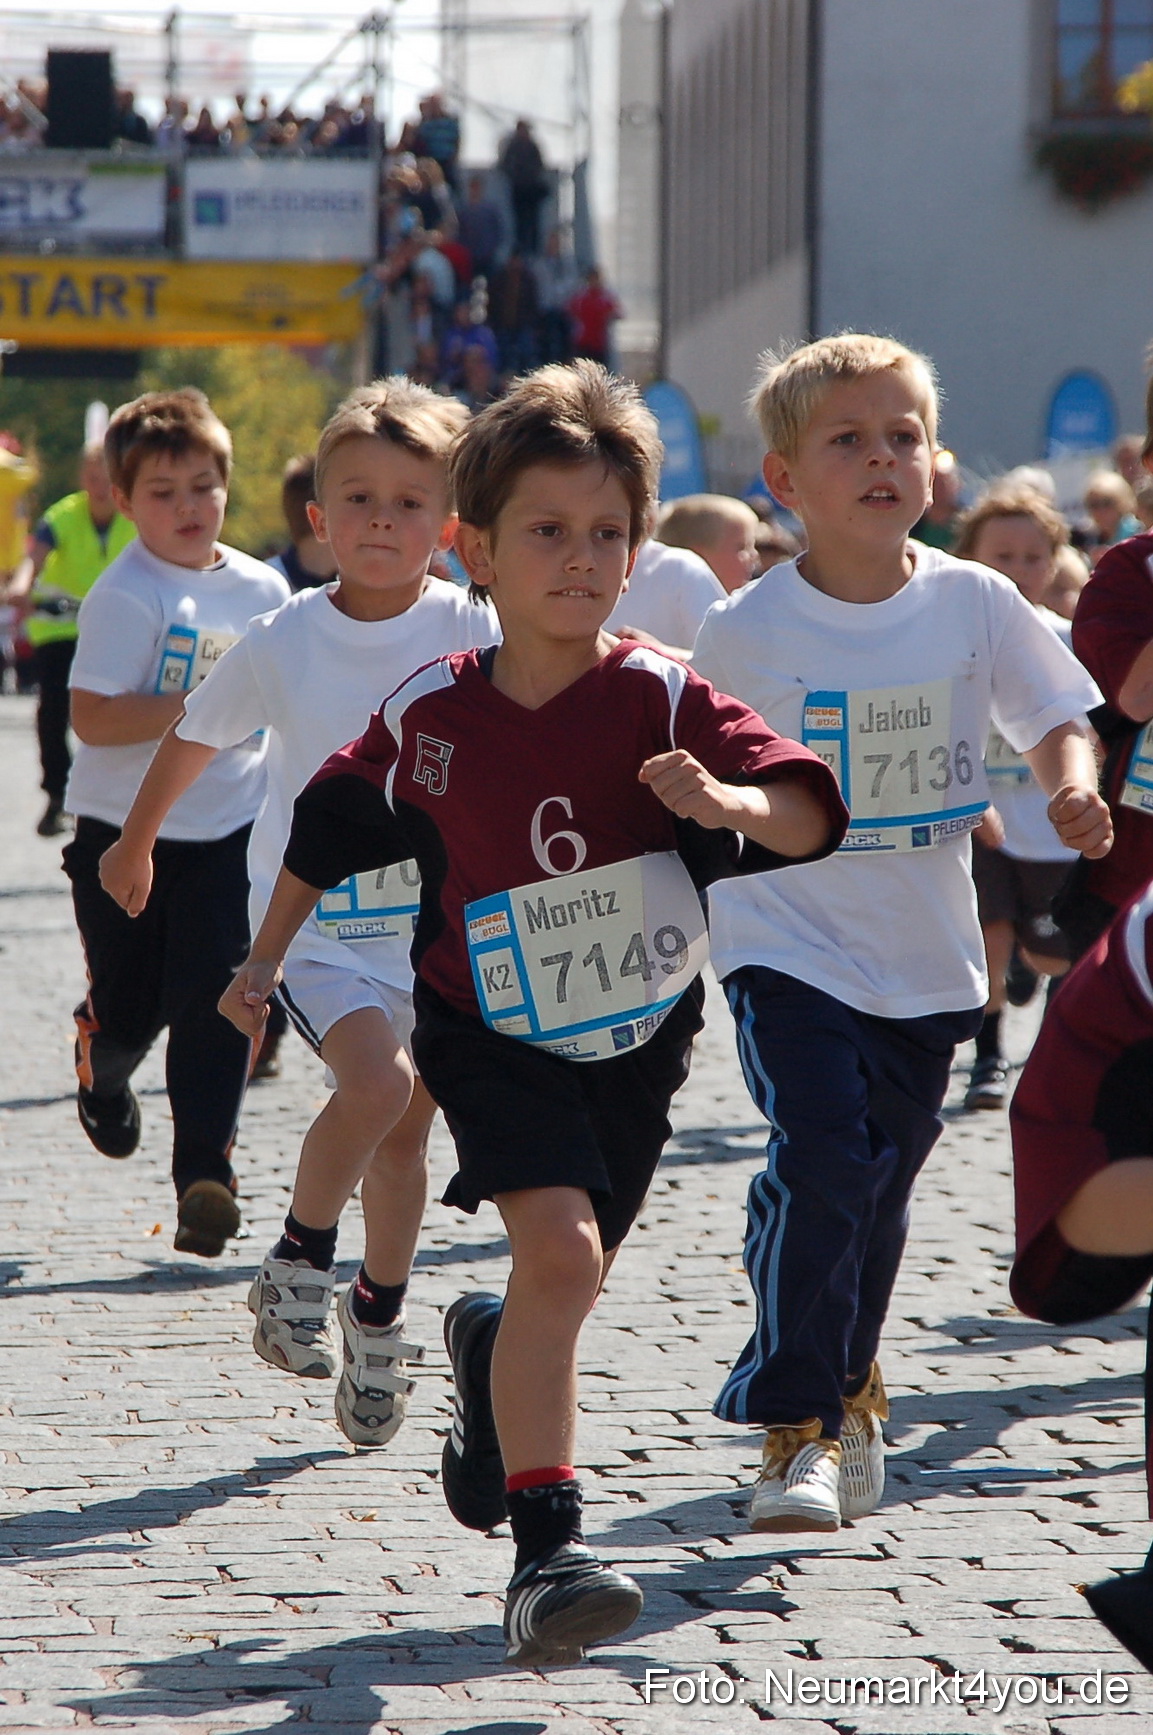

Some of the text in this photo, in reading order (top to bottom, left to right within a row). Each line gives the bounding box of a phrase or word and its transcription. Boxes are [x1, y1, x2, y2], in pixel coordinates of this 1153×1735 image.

[0, 272, 167, 318] TART
[859, 696, 932, 734] Jakob
[863, 740, 974, 798] 7136
[530, 796, 587, 877] 6
[523, 889, 621, 934] Moritz
[483, 963, 514, 994] K2
[540, 924, 689, 1004] 7149
